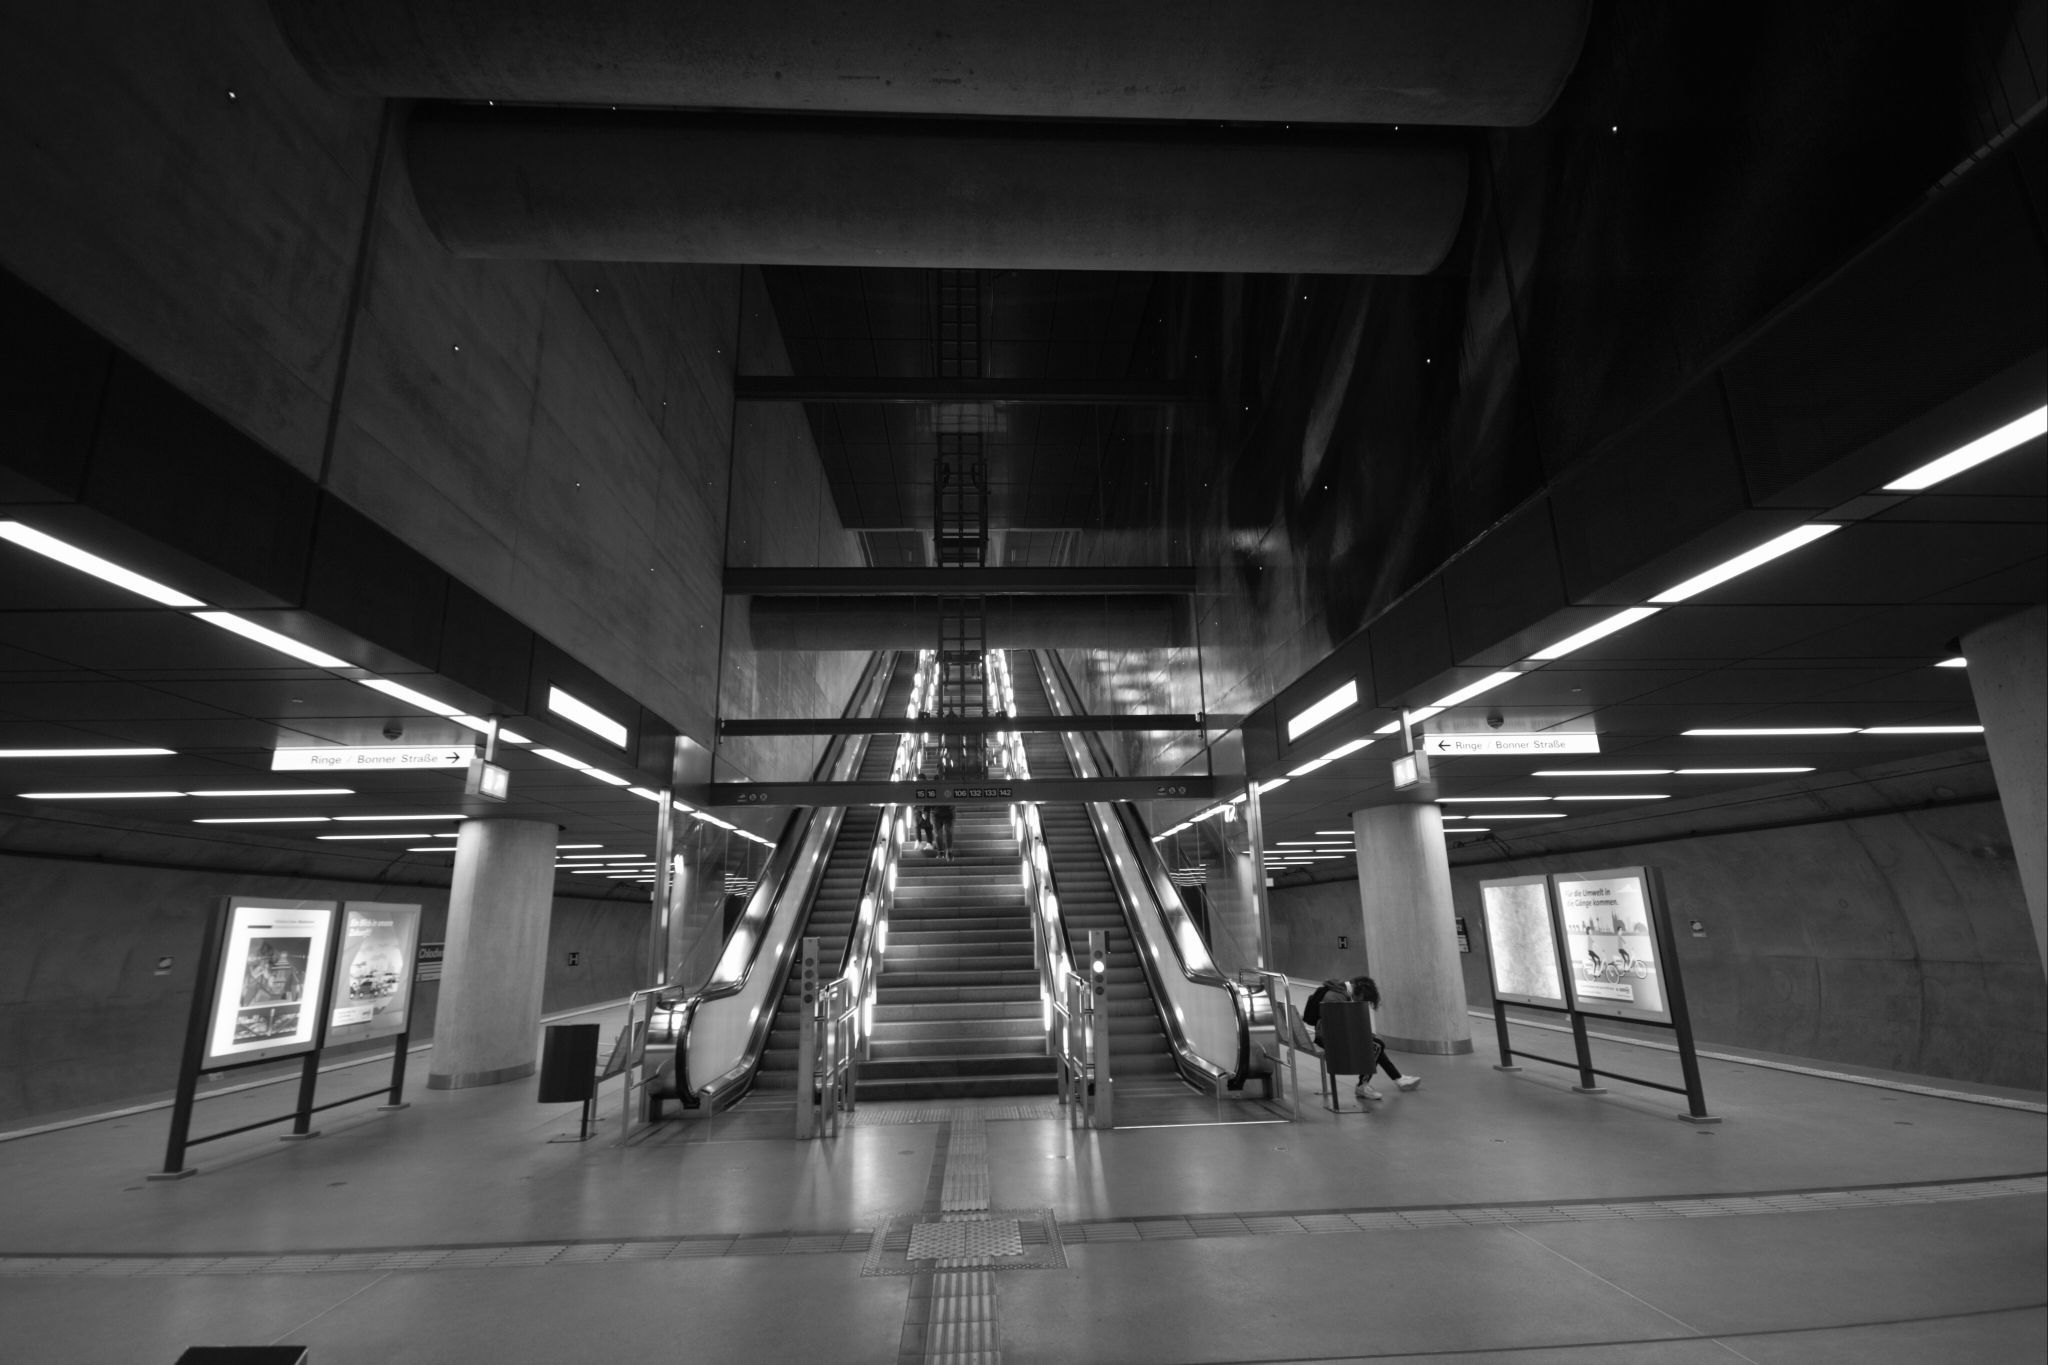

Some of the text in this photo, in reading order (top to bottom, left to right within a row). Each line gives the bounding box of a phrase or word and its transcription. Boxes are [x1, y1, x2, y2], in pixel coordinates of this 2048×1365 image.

[1455, 741, 1483, 751] Ringe
[1495, 741, 1529, 749] Bonner
[1533, 740, 1566, 749] Straße
[311, 755, 342, 765] Ringe
[357, 755, 396, 764] Bonner
[401, 754, 438, 763] Straße
[969, 789, 982, 797] 132
[1583, 888, 1604, 896] Umwelt
[1575, 899, 1592, 908] Gänge
